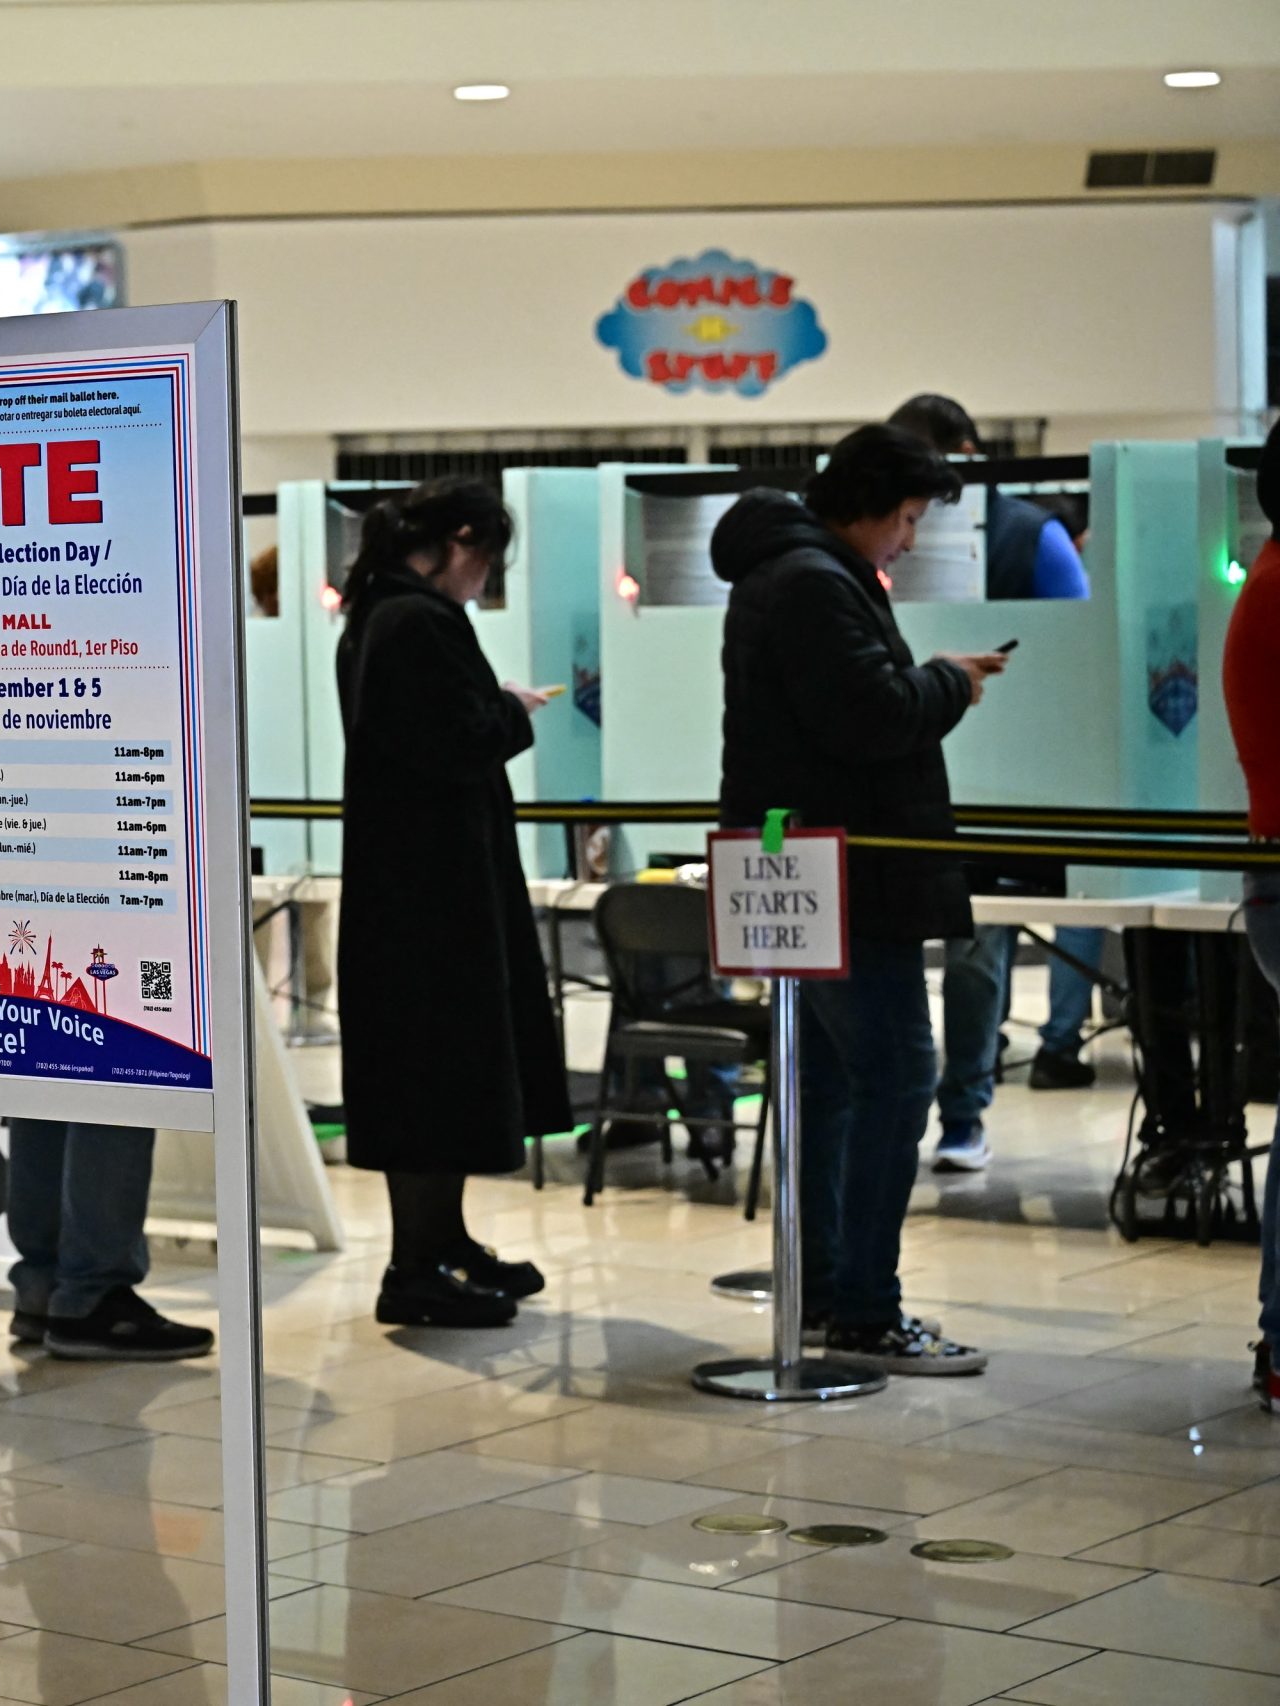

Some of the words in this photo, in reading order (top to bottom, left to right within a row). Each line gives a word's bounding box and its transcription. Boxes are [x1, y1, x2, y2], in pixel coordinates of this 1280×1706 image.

[14, 394, 27, 406] off
[27, 393, 48, 405] their
[49, 392, 69, 403] mail
[69, 391, 96, 402] ballot
[96, 390, 119, 401] here.
[65, 541, 100, 567] Day
[104, 539, 112, 560] /
[2, 575, 27, 596] Día
[31, 574, 51, 596] de
[55, 574, 70, 595] la
[74, 572, 142, 595] Elección
[2, 613, 52, 630] MALL
[11, 639, 27, 657] de
[30, 639, 82, 658] Round1,
[85, 639, 107, 656] 1er
[110, 638, 138, 655] Piso
[58, 677, 70, 698] 1
[74, 677, 87, 698] &
[91, 677, 102, 698] 5
[2, 708, 21, 729] de
[26, 708, 112, 730] noviembre
[118, 869, 169, 884] 11am-8pm
[744, 855, 801, 881] LINE
[729, 890, 818, 915] STARTS
[742, 925, 806, 950] HERE
[46, 1005, 105, 1047] Voice
